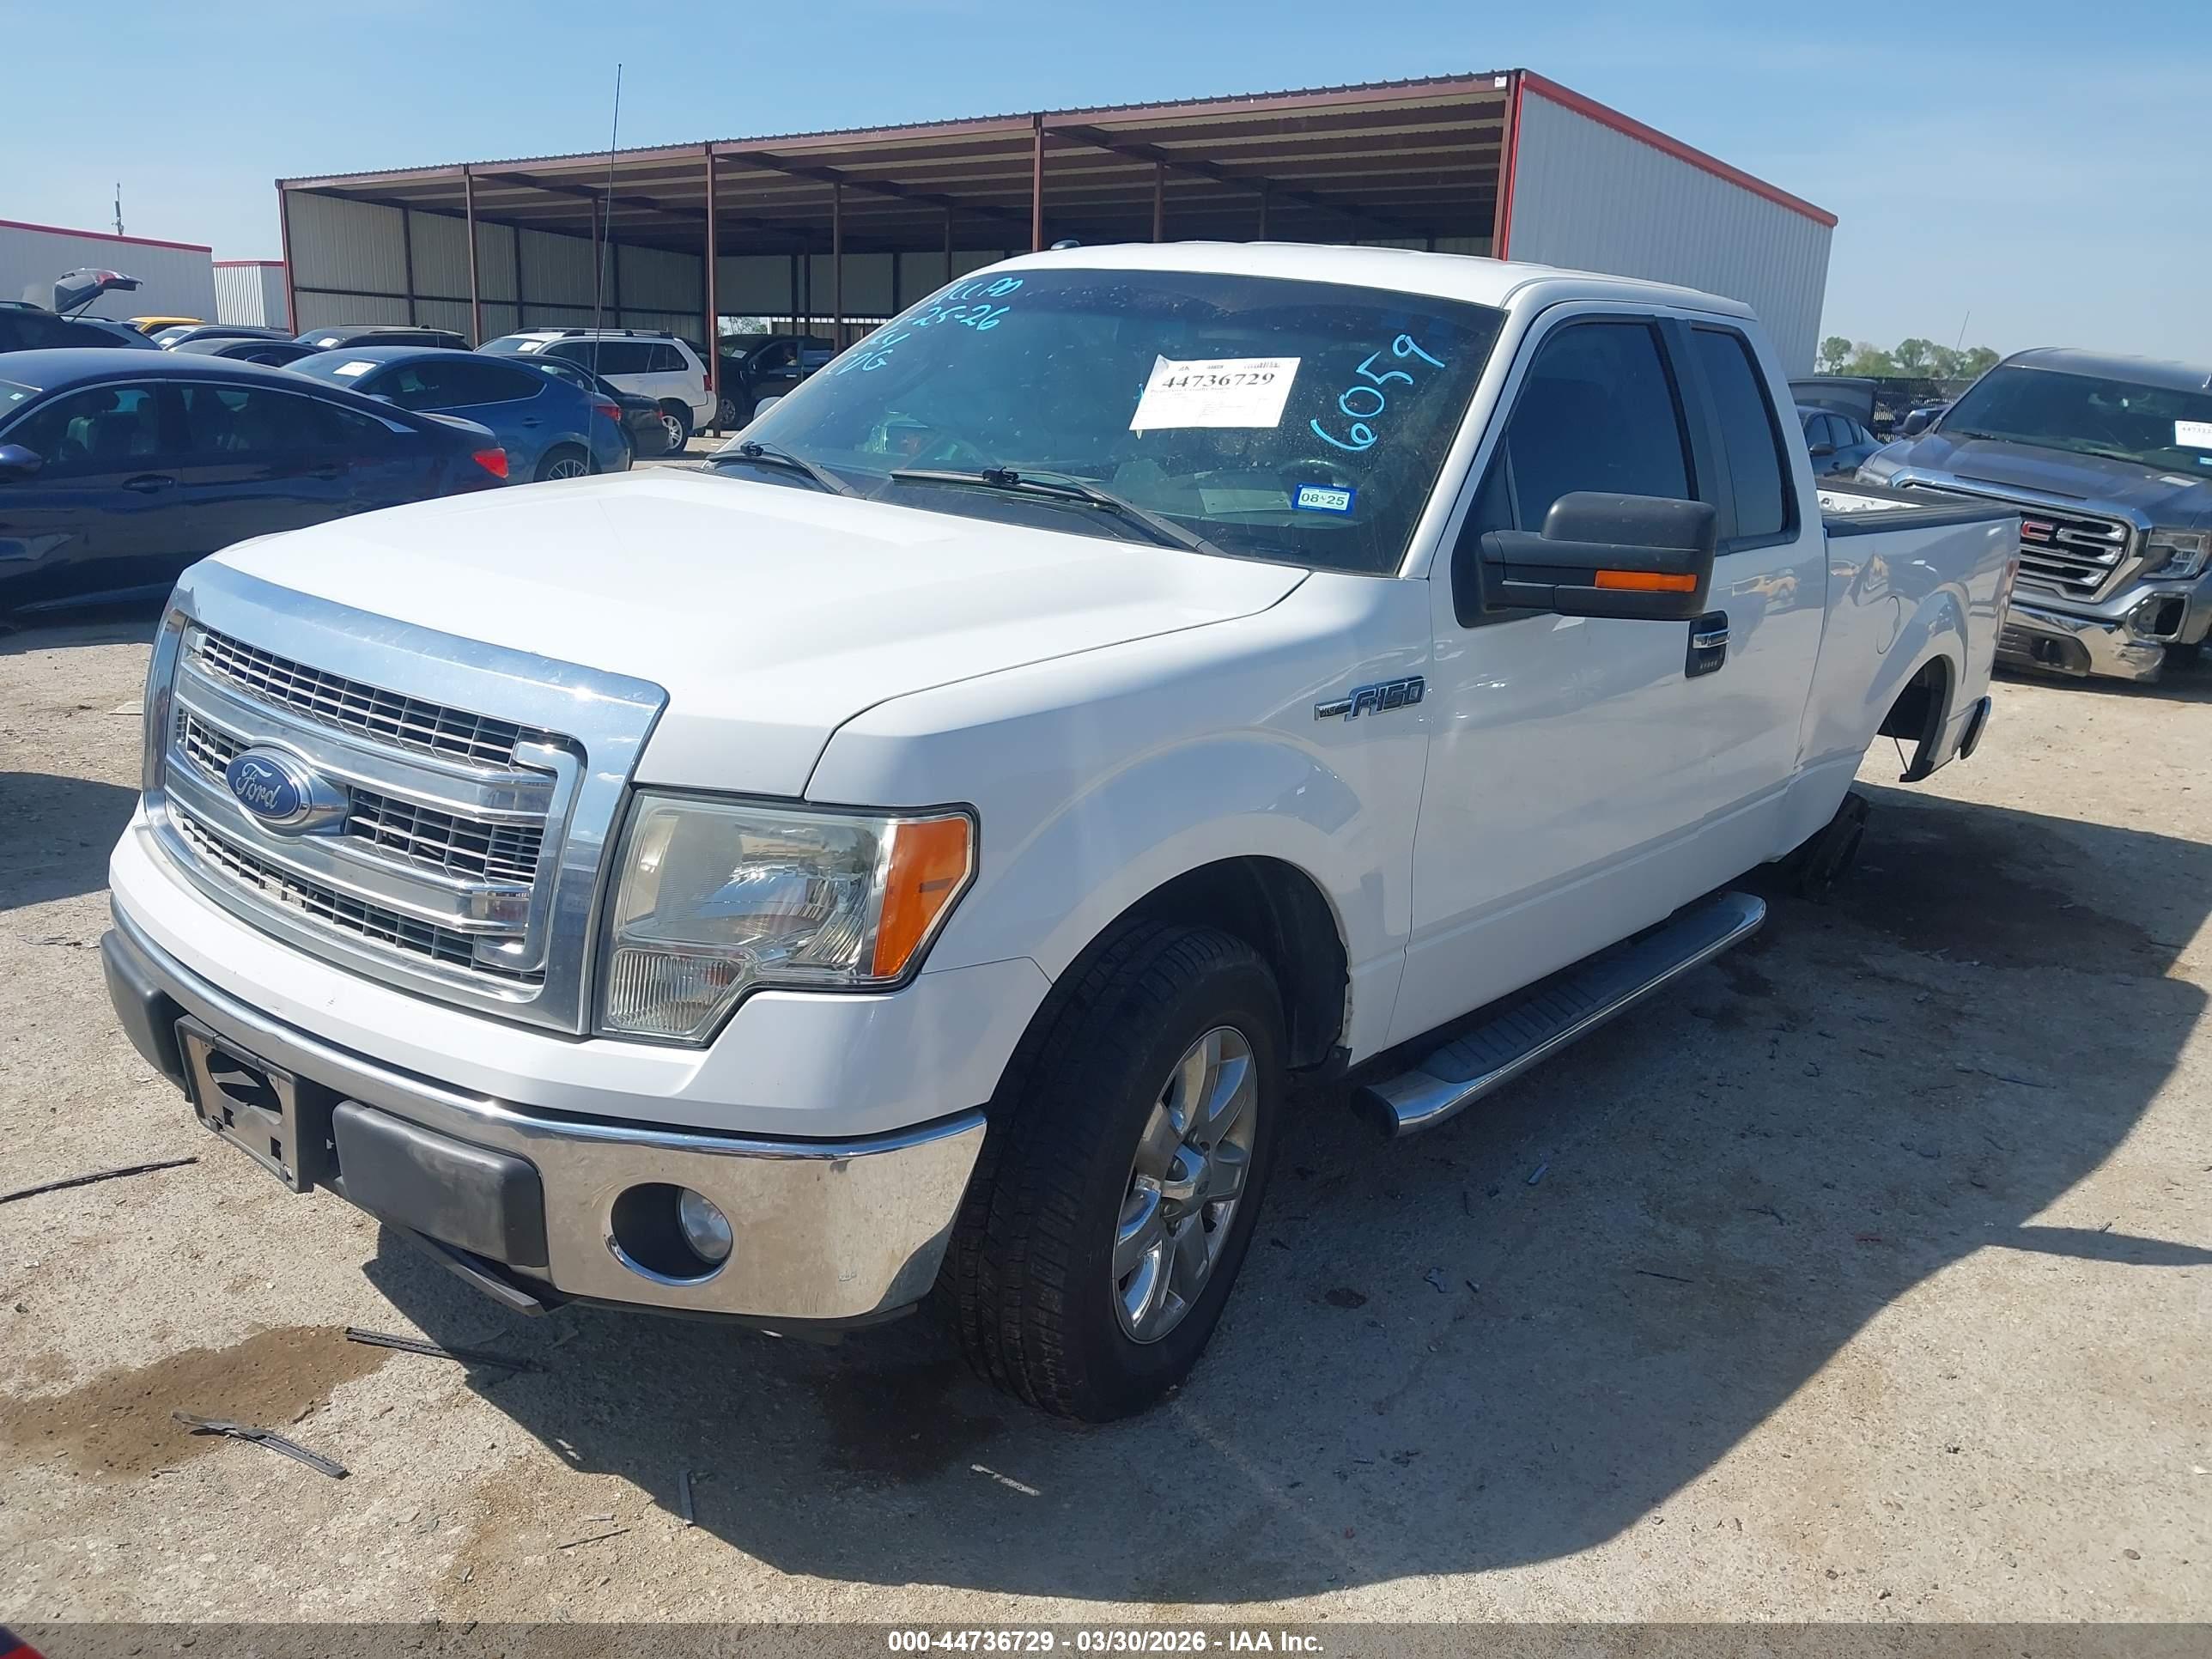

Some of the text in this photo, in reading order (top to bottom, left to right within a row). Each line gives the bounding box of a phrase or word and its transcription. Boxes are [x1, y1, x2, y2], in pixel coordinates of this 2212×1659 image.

[1162, 373, 1275, 388] 44736729
[1310, 334, 1445, 451] 6059
[1301, 493, 1345, 506] 08 25
[235, 763, 282, 809] Ford
